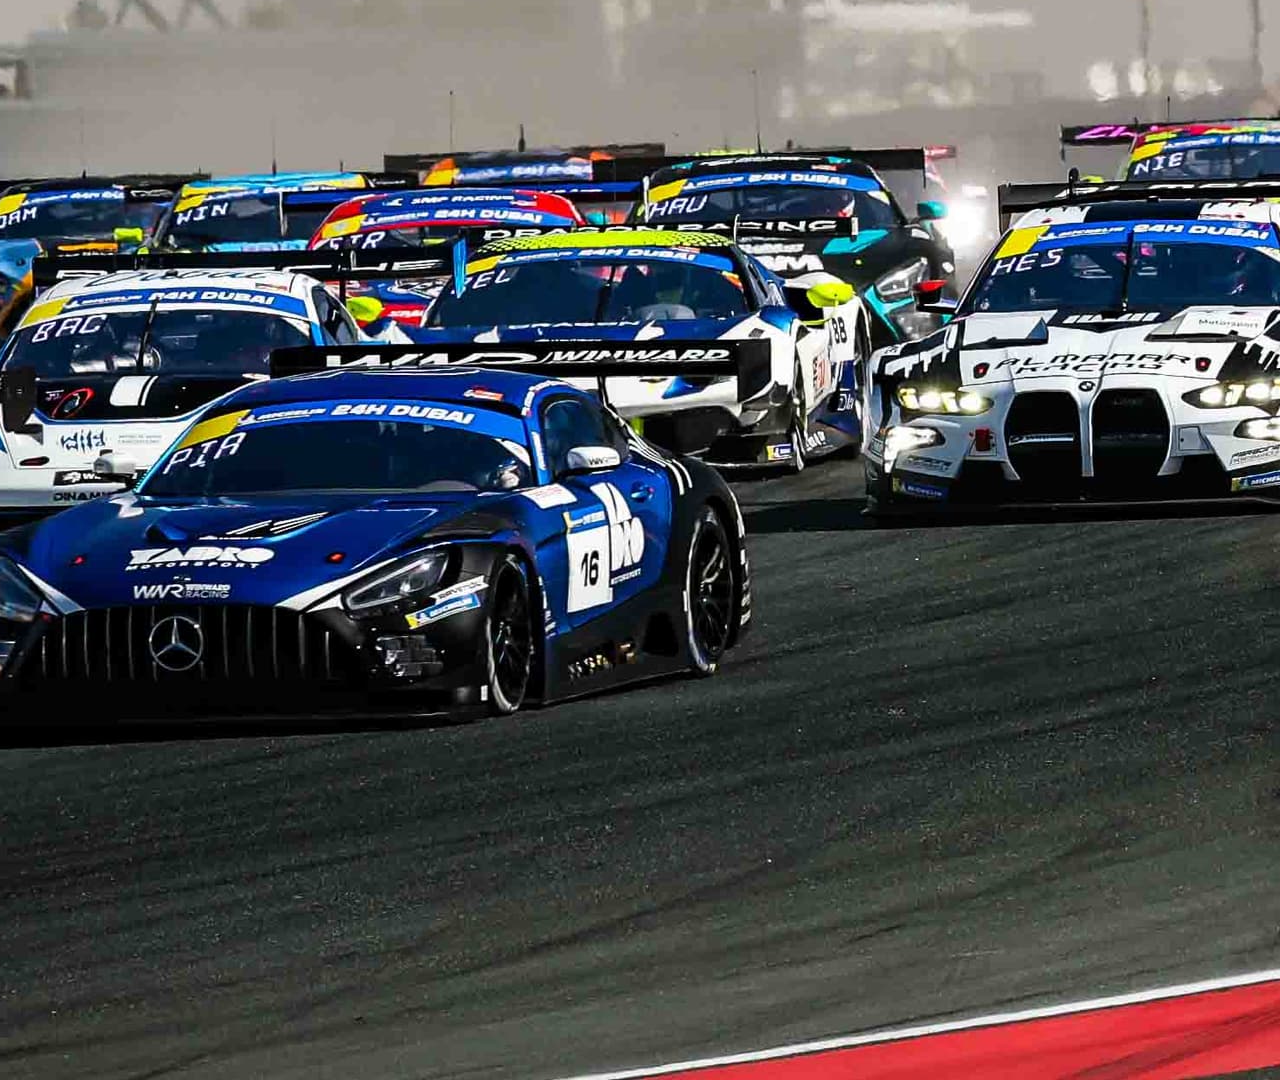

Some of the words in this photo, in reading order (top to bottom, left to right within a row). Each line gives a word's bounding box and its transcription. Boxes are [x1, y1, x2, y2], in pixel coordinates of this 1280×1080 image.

[1133, 152, 1185, 175] NIE
[791, 173, 848, 185] DUBAI
[479, 209, 543, 223] DUBAI
[1133, 223, 1185, 233] 24H
[1188, 224, 1270, 240] DUBAI
[627, 249, 697, 261] DUBAI
[991, 248, 1064, 276] HES
[200, 291, 275, 305] DUBAI
[32, 315, 108, 343] BAC
[831, 317, 848, 344] 88
[552, 349, 731, 363] WINWARD
[330, 403, 386, 416] 24H
[389, 404, 475, 424] DUBAI
[163, 432, 247, 474] PIA
[125, 561, 261, 571] MOTORSPORT
[580, 550, 600, 588] 16
[185, 591, 231, 599] RACING
